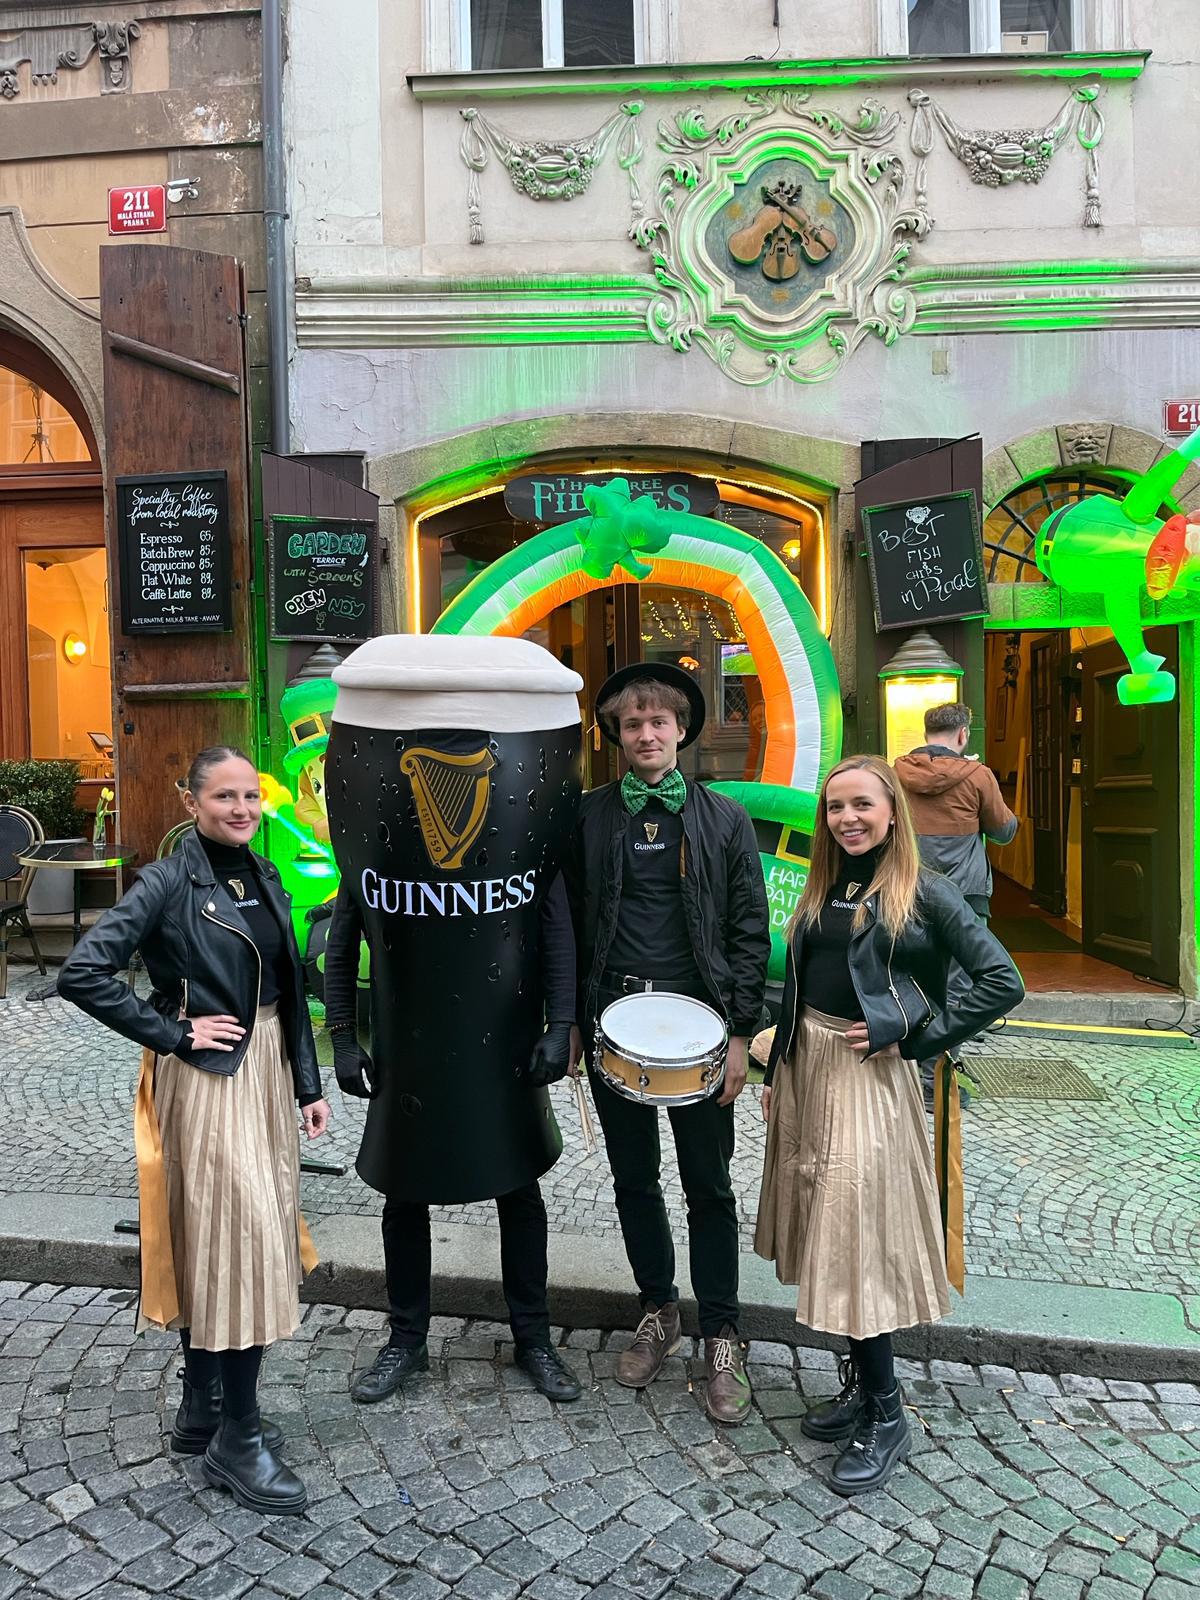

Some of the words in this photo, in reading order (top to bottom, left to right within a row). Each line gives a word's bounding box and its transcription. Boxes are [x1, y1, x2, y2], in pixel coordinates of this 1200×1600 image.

[123, 191, 150, 210] 211
[133, 210, 155, 218] STRANA
[1178, 404, 1200, 423] 21
[132, 488, 181, 513] Specialty
[181, 484, 214, 515] Coffee
[126, 506, 154, 526] from
[155, 503, 182, 519] local
[140, 532, 183, 547] Espresso
[288, 531, 366, 558] GARDEN
[140, 547, 167, 559] Batch
[167, 546, 194, 558] Brew
[907, 546, 941, 564] FISH
[140, 560, 196, 574] Cappuccino
[284, 568, 306, 577] WITH
[906, 565, 942, 580] CHIPS
[142, 574, 159, 586] Flat
[161, 572, 192, 585] White
[168, 587, 192, 600] Latte
[901, 589, 923, 610] in
[285, 588, 327, 615] OPEN
[328, 598, 366, 618] NOW
[426, 829, 442, 852] 1759
[361, 868, 536, 917] GUINNESS
